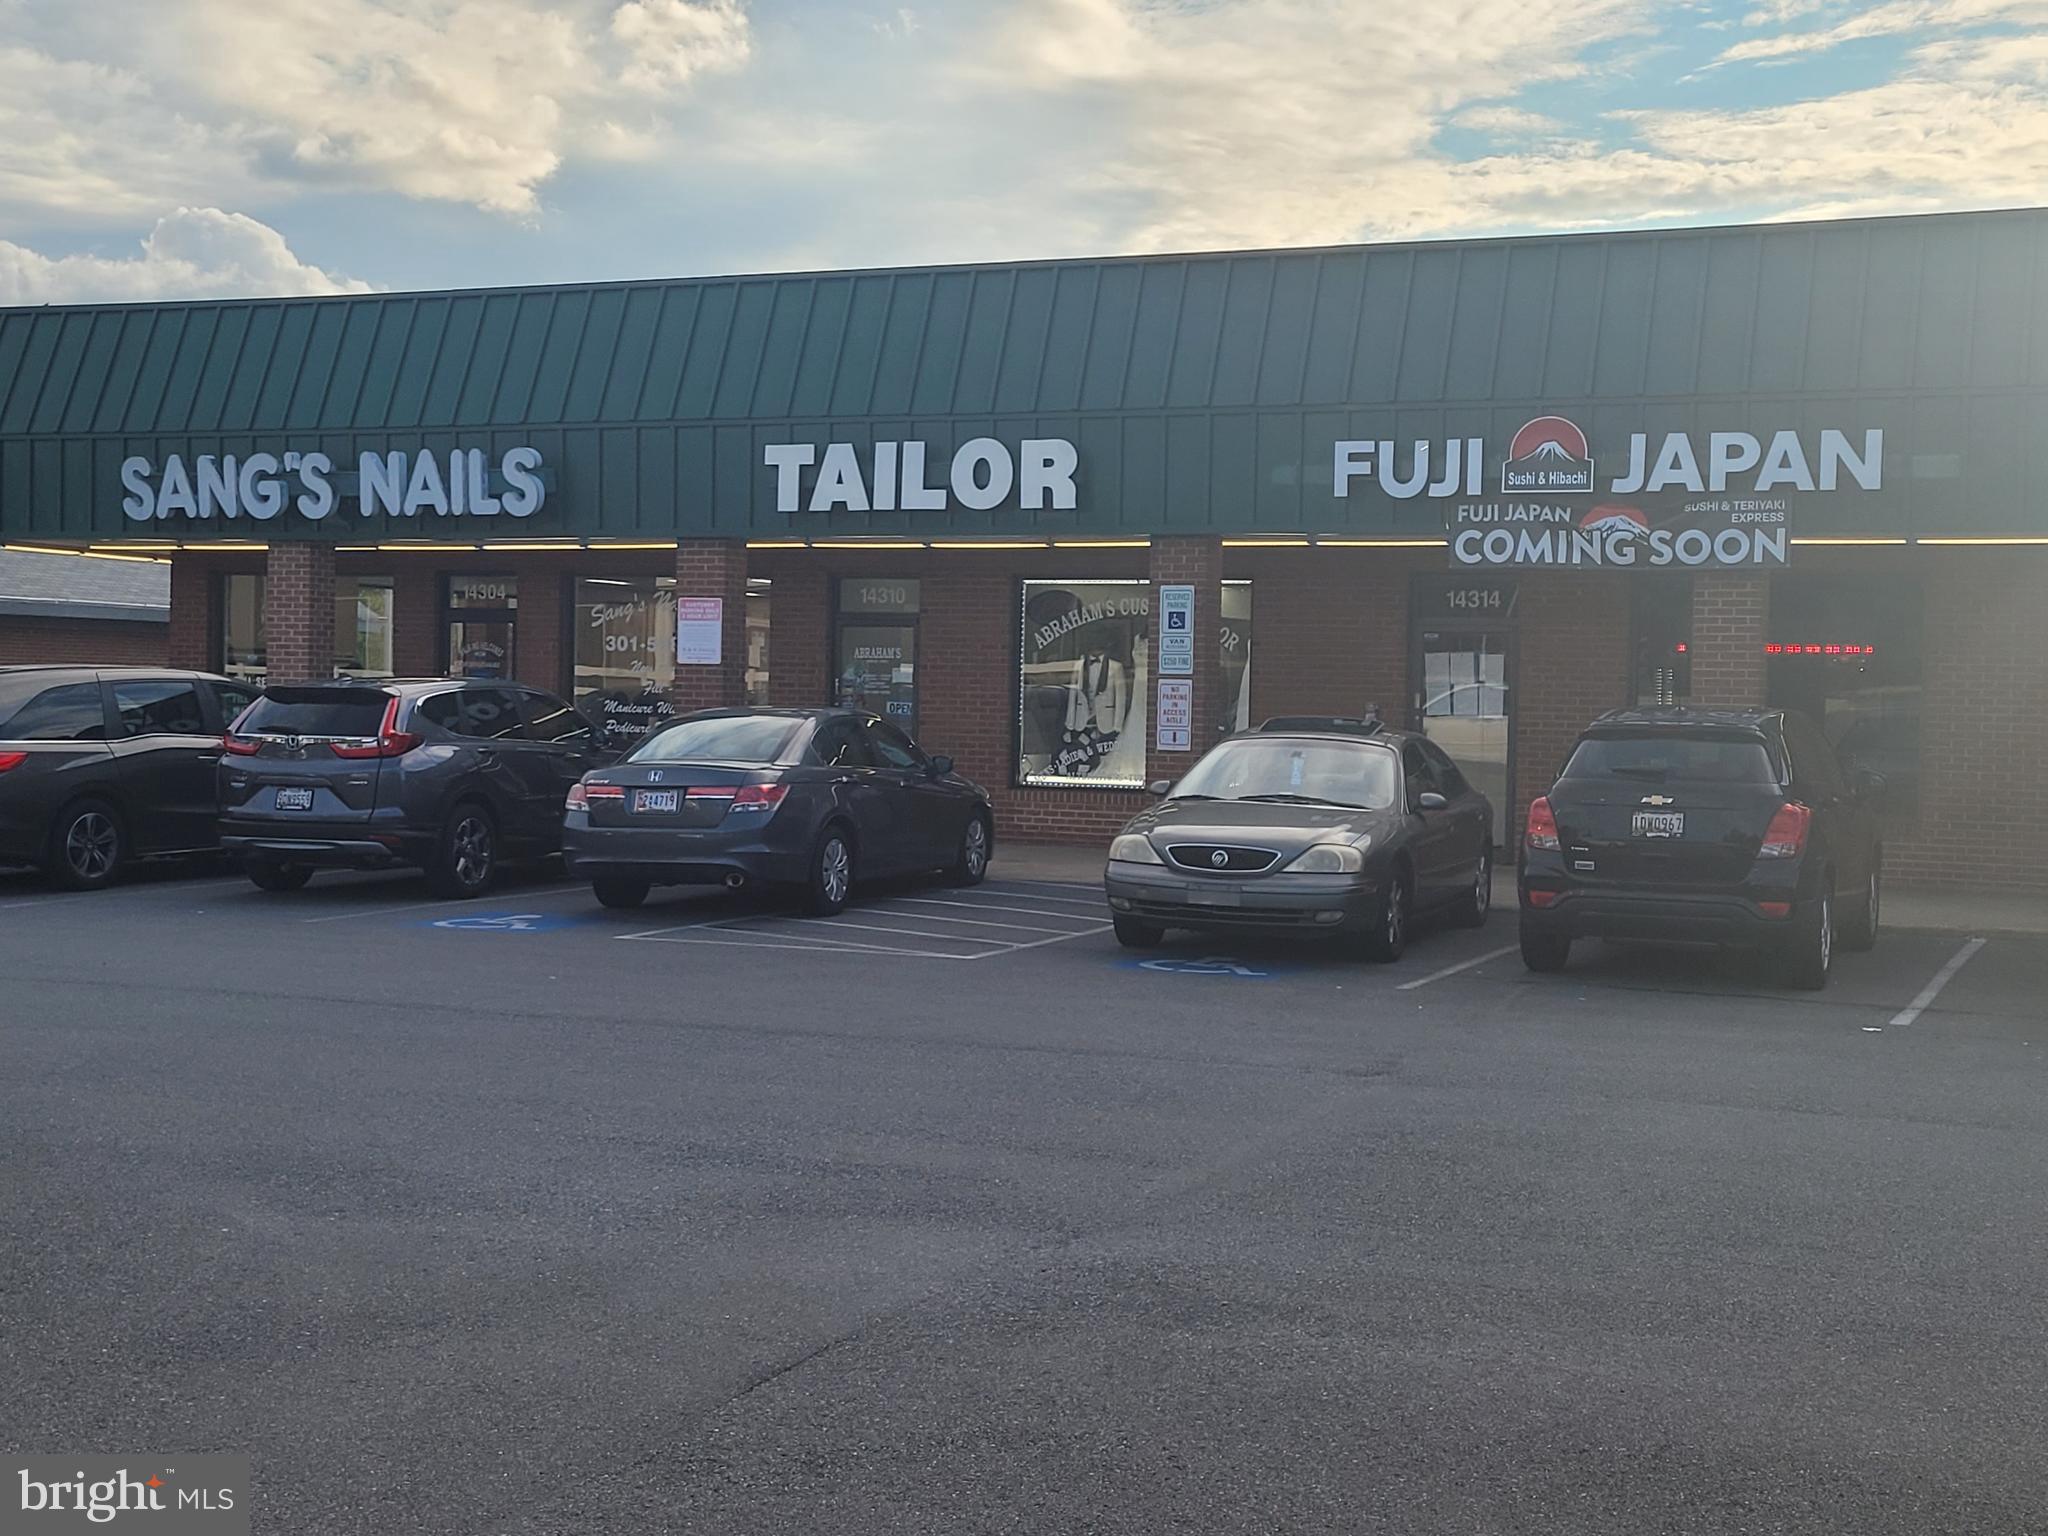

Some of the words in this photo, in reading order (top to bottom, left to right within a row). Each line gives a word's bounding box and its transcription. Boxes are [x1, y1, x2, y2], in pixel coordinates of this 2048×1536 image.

[1333, 438, 1484, 498] FUJI
[1611, 428, 1884, 494] JAPAN
[121, 451, 338, 520] SANG'S
[359, 446, 546, 518] NAILS
[765, 437, 1078, 512] TAILOR
[1508, 471, 1535, 485] Sushi
[1538, 472, 1546, 485] &
[1549, 470, 1587, 485] Hibachi
[1458, 504, 1499, 522] FUJI
[1504, 504, 1572, 523] JAPAN
[1684, 501, 1719, 512] SUSHI
[1721, 501, 1730, 511] &
[1733, 499, 1786, 511] TERIYAKI
[1731, 512, 1785, 523] EXPRESS
[1455, 528, 1636, 565] COMING
[1649, 527, 1786, 565] SOON
[463, 584, 506, 600] 14304
[861, 587, 905, 604] 14310
[1447, 589, 1502, 608] 14314
[591, 593, 648, 627] Sang's
[1033, 598, 1116, 649] ABRAHAM'S
[604, 700, 654, 714] Manicure
[606, 719, 650, 733] Pedicure
